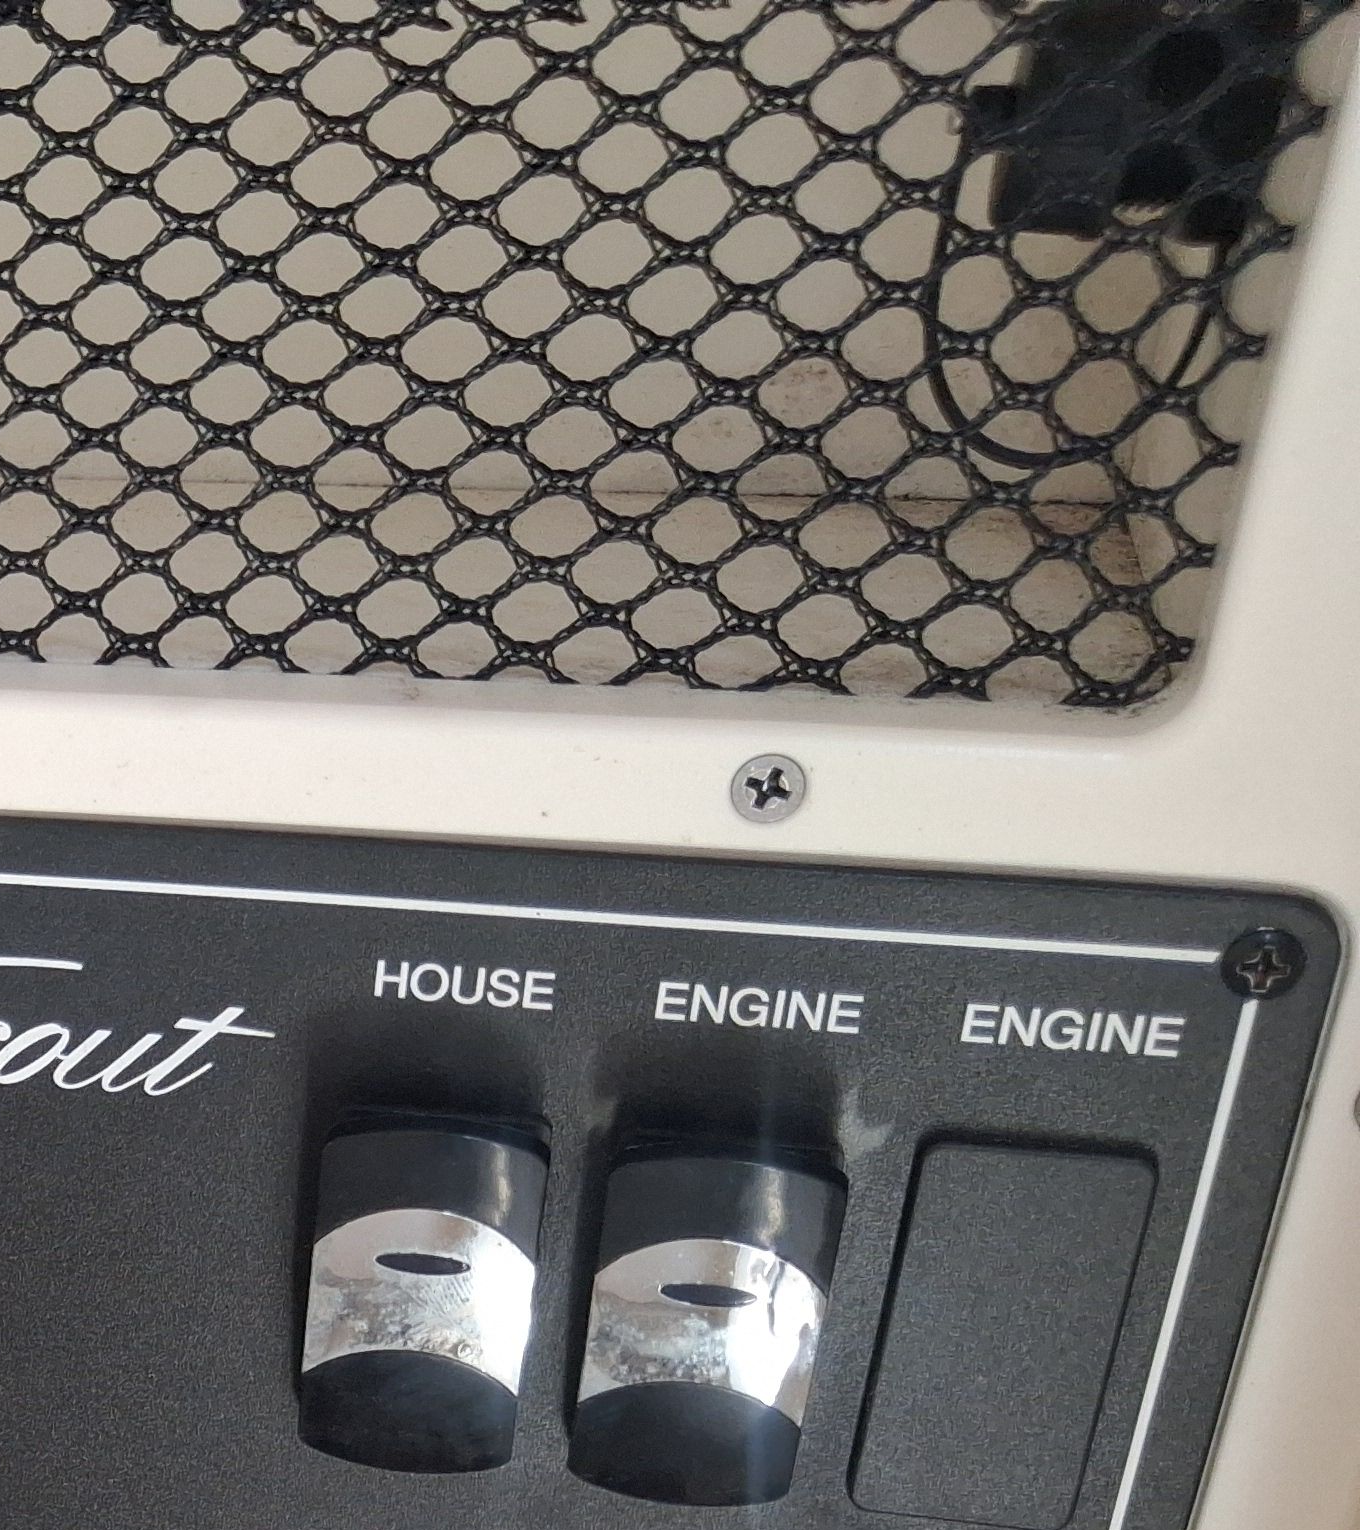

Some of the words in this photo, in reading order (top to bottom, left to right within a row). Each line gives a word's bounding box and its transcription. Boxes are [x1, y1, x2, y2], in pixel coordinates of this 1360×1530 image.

[373, 959, 556, 1011] HOUSE
[654, 981, 865, 1035] ENGINE
[960, 1003, 1186, 1058] ENGINE
